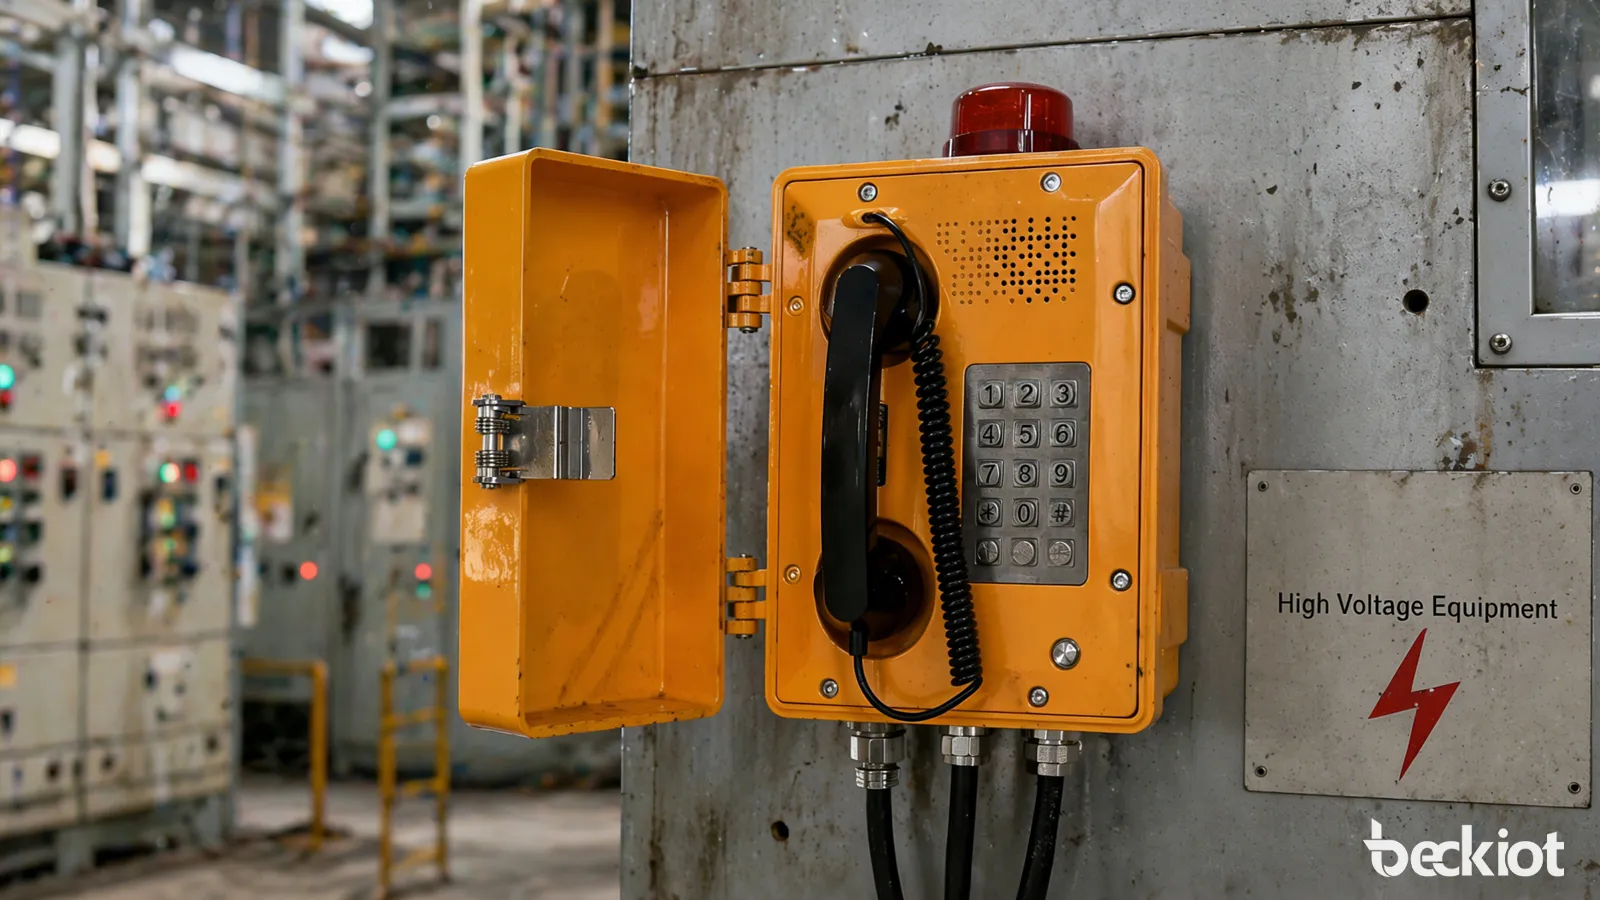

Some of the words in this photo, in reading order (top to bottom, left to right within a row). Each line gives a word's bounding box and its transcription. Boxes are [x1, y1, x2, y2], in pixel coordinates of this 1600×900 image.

[985, 385, 993, 404] 1
[1020, 385, 1033, 403] 2
[1056, 384, 1069, 403] 3
[982, 424, 995, 444] 4
[1019, 424, 1032, 444] 5
[1056, 424, 1069, 443] 6
[983, 464, 995, 484] 7
[1019, 464, 1031, 483] 8
[1055, 464, 1068, 483] 9
[1018, 503, 1030, 522] 0
[1278, 592, 1329, 619] High
[1337, 593, 1424, 621] Voltage
[1432, 595, 1558, 623] Equipment
